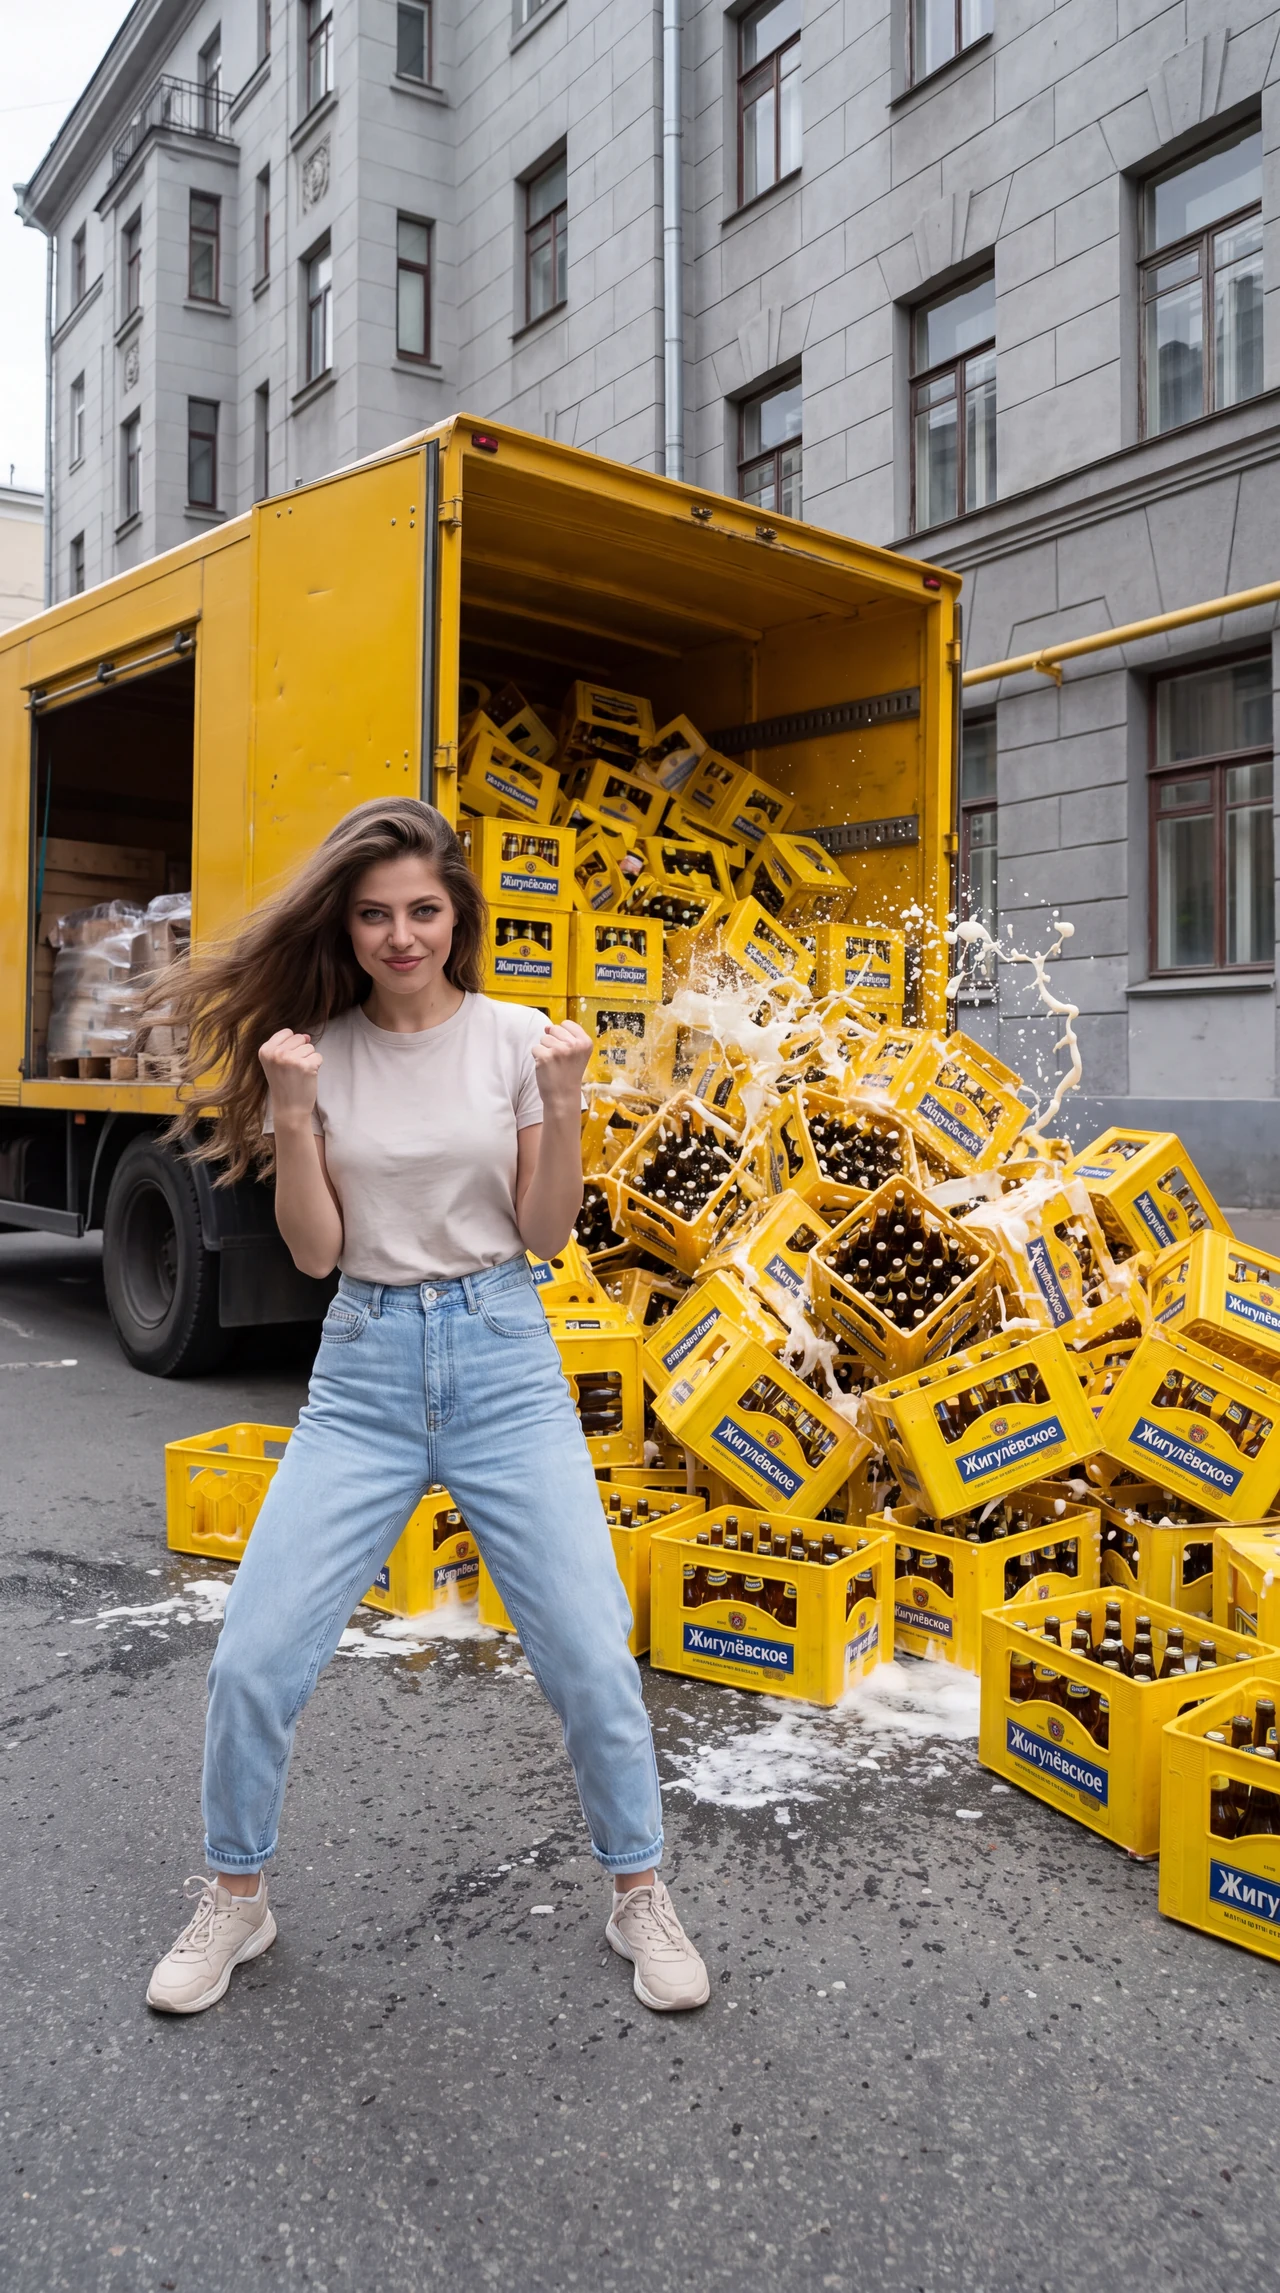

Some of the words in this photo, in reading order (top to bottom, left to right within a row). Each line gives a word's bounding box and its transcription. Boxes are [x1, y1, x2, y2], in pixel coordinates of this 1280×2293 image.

[718, 1423, 796, 1491] Жигулёвское
[962, 1425, 1058, 1476] Жигулёвское
[1136, 1423, 1235, 1487] Жигулёвское
[688, 1628, 789, 1665] Жигулёвское
[1011, 1726, 1103, 1793] Жигулёвское
[1218, 1868, 1280, 1919] Жигу
